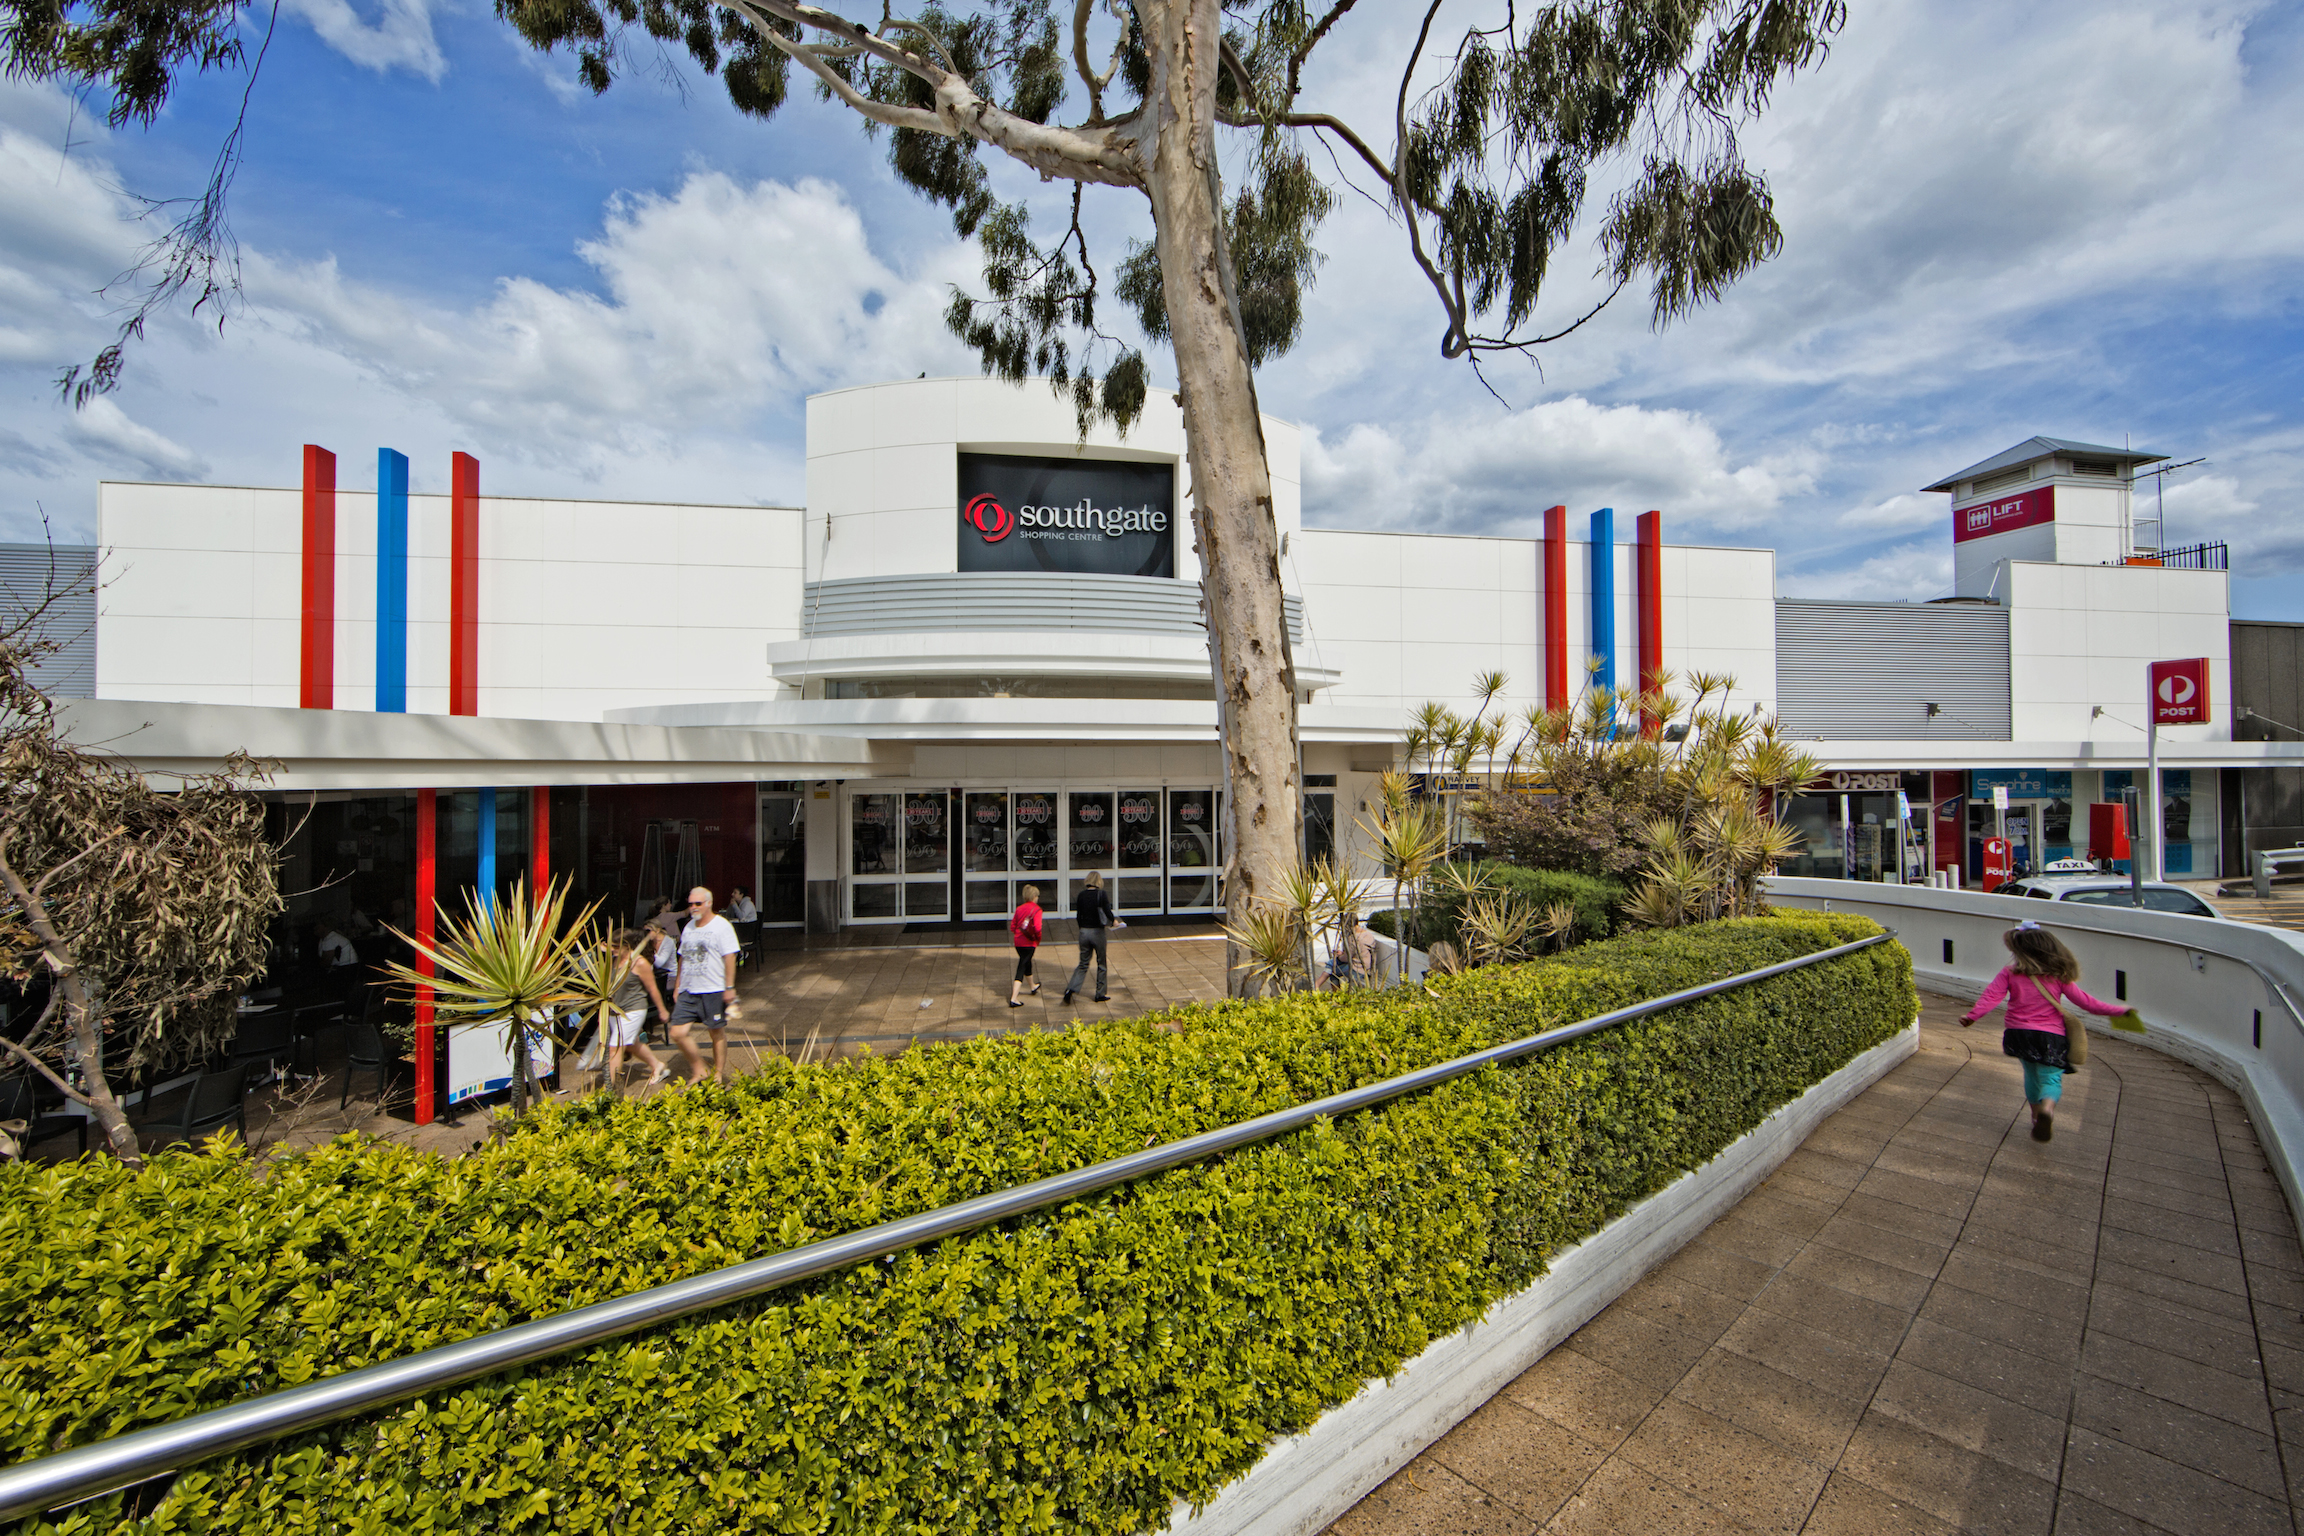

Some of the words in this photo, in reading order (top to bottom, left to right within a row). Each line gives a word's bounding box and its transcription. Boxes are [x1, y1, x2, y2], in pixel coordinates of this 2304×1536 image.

[1993, 500, 2024, 517] LIFT
[1019, 498, 1168, 537] southgate
[1019, 531, 1065, 541] SHOPPING
[1068, 532, 1103, 542] CENTRE
[2159, 707, 2196, 717] POST
[1849, 773, 1898, 789] POST
[2007, 817, 2029, 825] OPEN
[2009, 825, 2015, 836] 7
[1985, 868, 2011, 876] POST
